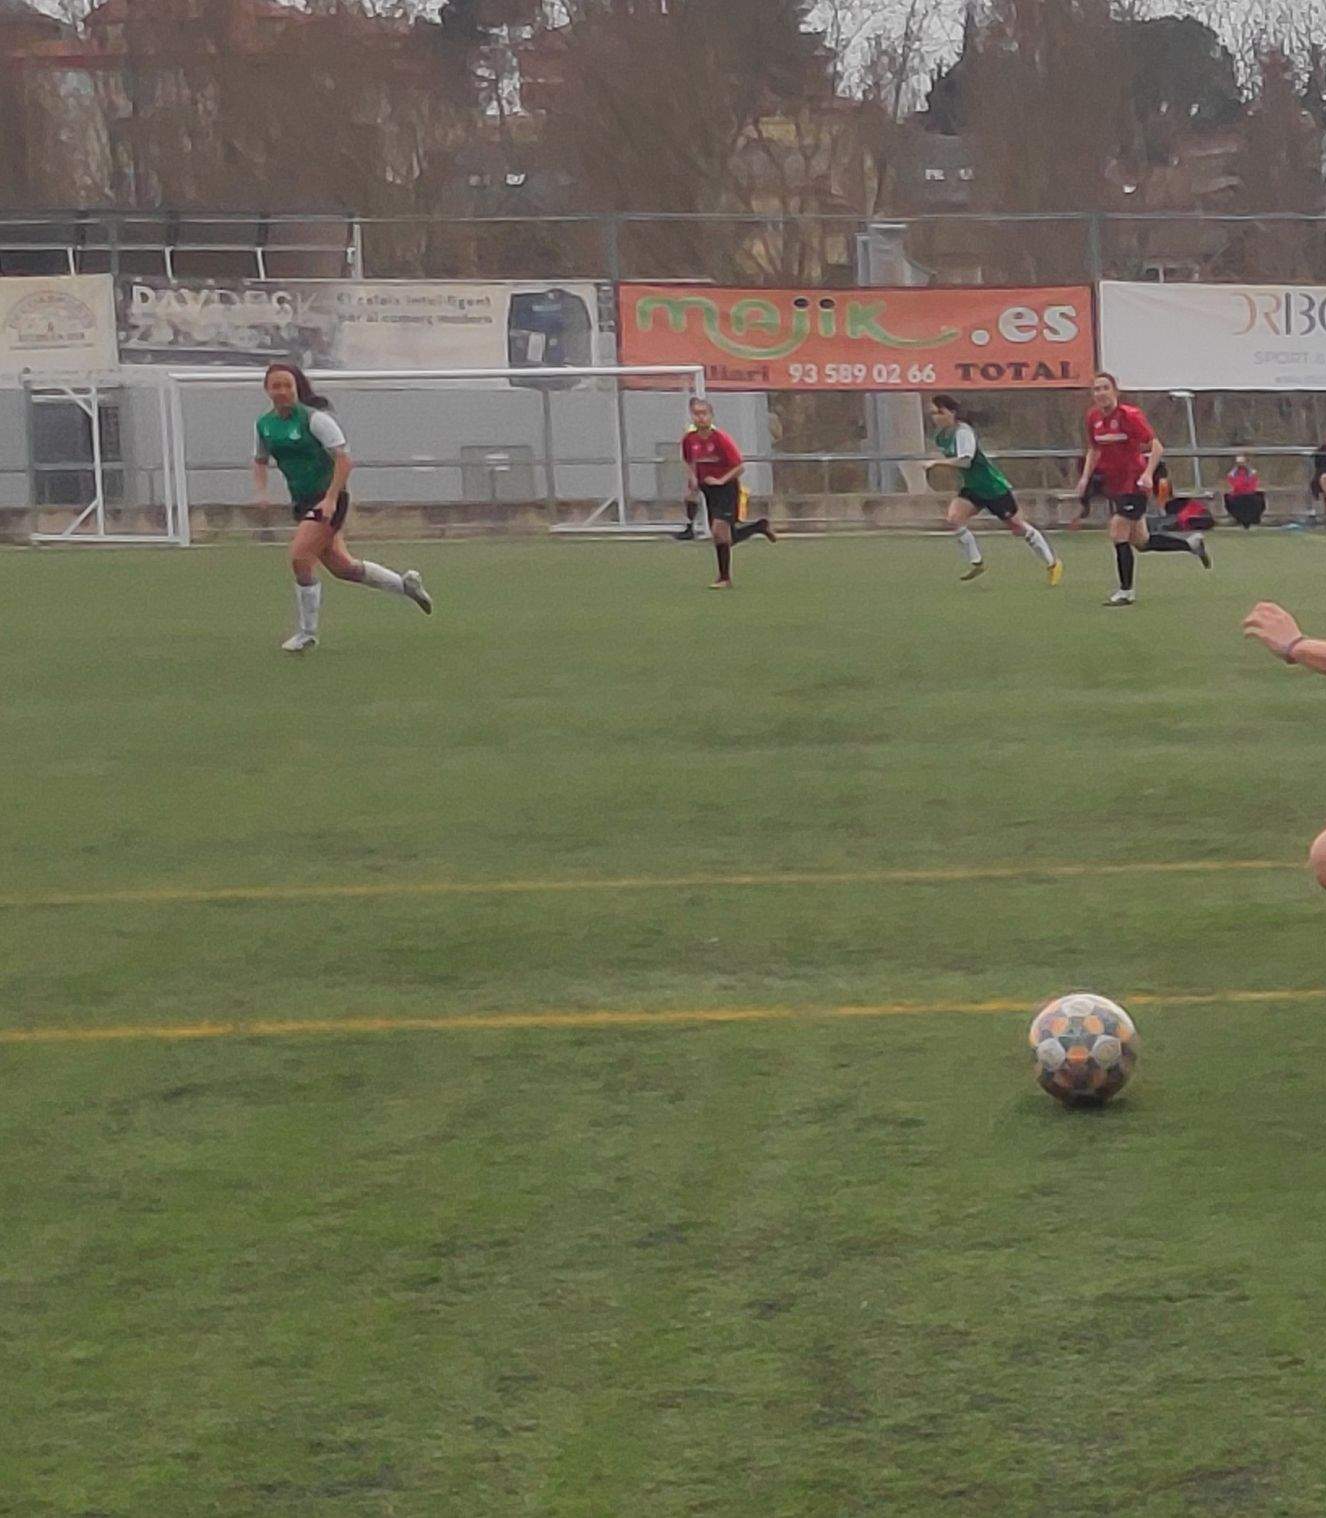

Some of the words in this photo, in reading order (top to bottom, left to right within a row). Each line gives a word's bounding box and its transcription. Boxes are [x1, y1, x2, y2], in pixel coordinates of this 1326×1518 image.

[1253, 351, 1309, 365] SPORT
[788, 363, 818, 384] 93
[825, 363, 864, 384] 589
[872, 363, 901, 383] 02
[907, 363, 936, 383] 66
[955, 360, 1080, 381] TOTAL
